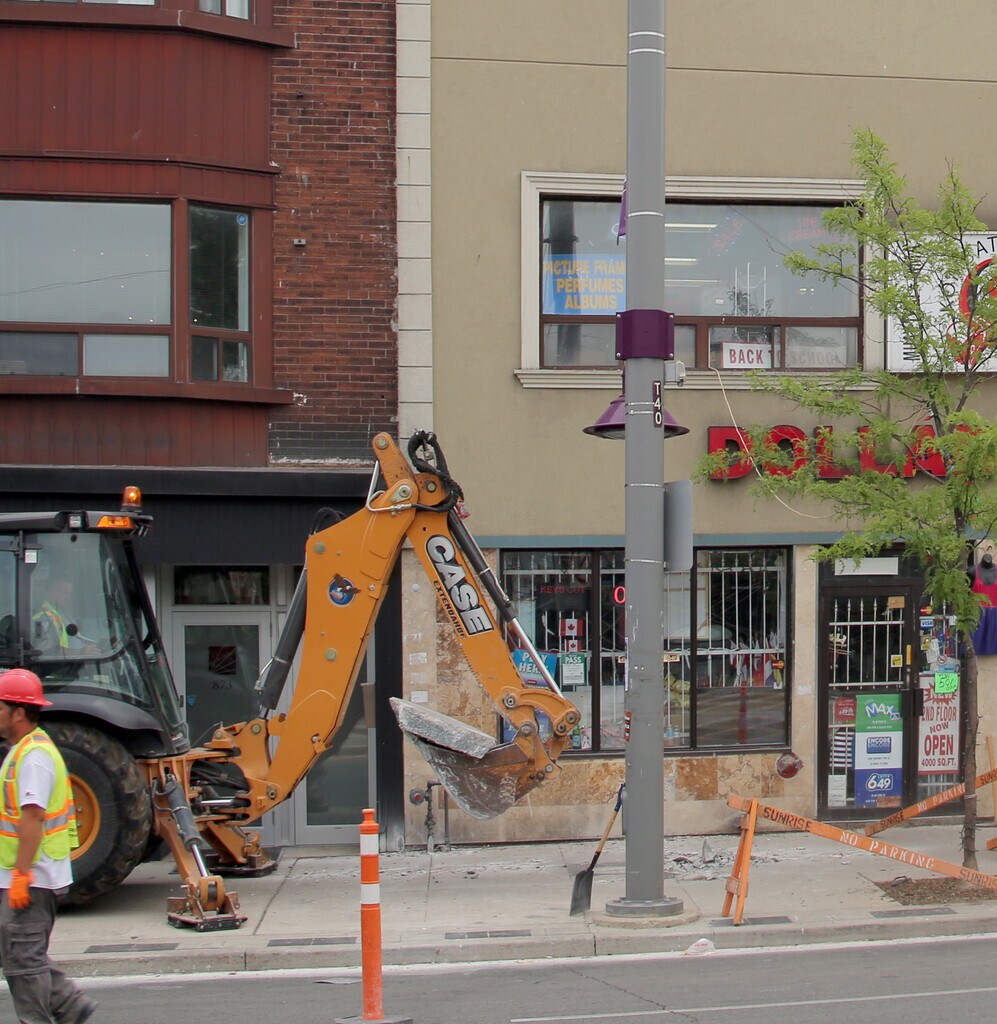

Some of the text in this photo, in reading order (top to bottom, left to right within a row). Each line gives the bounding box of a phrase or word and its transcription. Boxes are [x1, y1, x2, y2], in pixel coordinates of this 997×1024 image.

[543, 259, 590, 275] PICTURE
[557, 278, 624, 293] PERFUMES
[565, 295, 617, 309] ALBUMS
[729, 349, 763, 364] BACK
[426, 534, 494, 636] CASE
[540, 586, 586, 594] KEYS CUT
[936, 706, 957, 722] FLOOR
[929, 722, 949, 734] NOW
[924, 735, 954, 756] OPEN
[937, 757, 957, 766] SQ.FT.
[763, 806, 811, 831] SUNRISE
[880, 812, 905, 831] SUNRISE
[839, 831, 935, 870] NO PARKING
